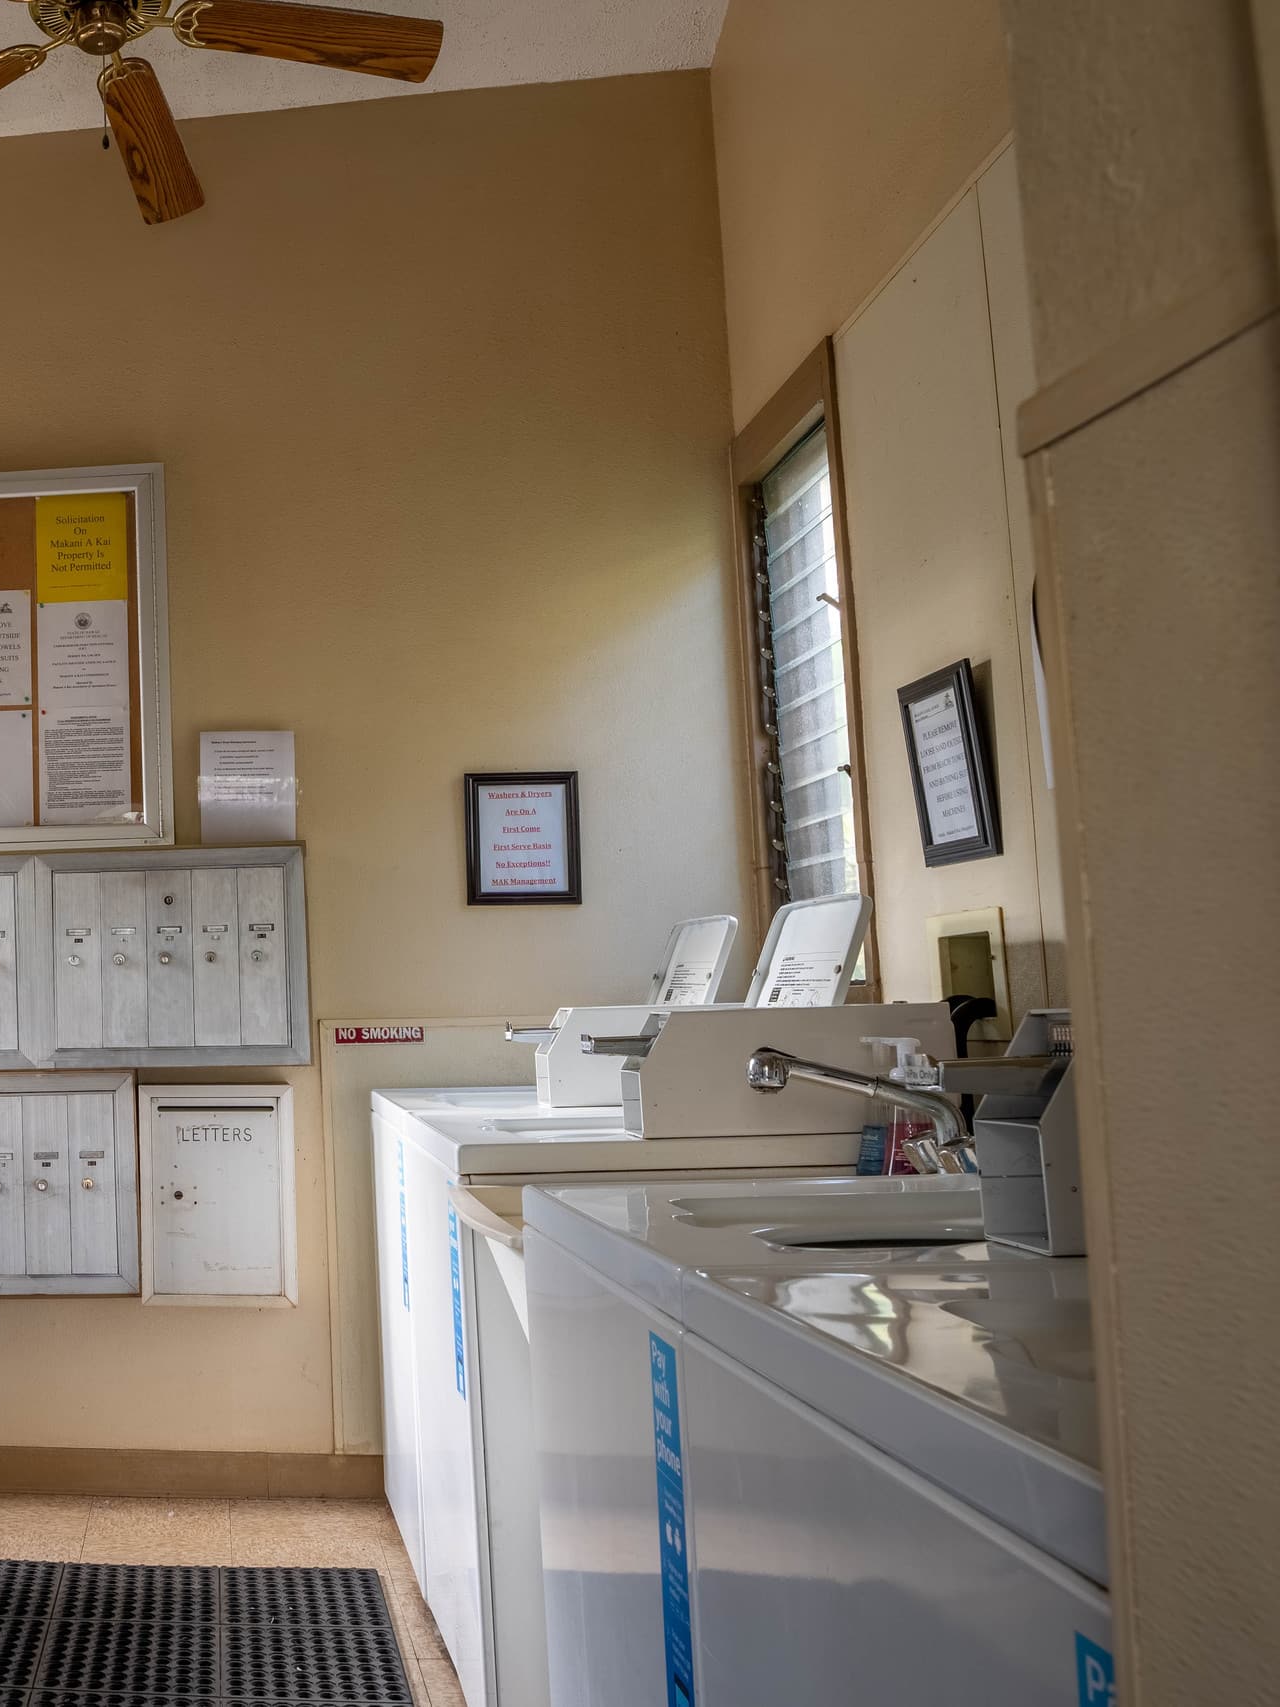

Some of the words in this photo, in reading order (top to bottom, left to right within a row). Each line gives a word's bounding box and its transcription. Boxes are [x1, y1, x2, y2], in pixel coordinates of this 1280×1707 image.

[56, 514, 105, 525] Solicitation
[73, 527, 87, 535] On
[50, 539, 83, 549] Makani
[86, 538, 92, 546] A
[96, 537, 111, 546] Kai
[57, 550, 93, 561] Property
[97, 550, 104, 558] Is
[51, 564, 67, 573] Not
[70, 561, 111, 572] Permitted
[922, 726, 938, 741] PLEASE
[937, 719, 957, 734] REMOVE
[920, 745, 935, 759] LOOSE
[935, 741, 946, 753] SAND
[923, 762, 937, 775] FROM
[937, 757, 951, 770] BEACH
[928, 779, 939, 789] AND
[939, 772, 958, 787] BATHING
[488, 791, 519, 799] Washers
[528, 791, 552, 799] Dryers
[936, 791, 952, 803] BEFORE
[952, 786, 968, 799] USING
[519, 808, 530, 816] On
[942, 804, 966, 818] MACHINES
[521, 825, 541, 833] Come
[493, 843, 510, 851] First
[507, 860, 551, 869] Exceptions!!
[510, 877, 557, 886] Management
[338, 1028, 356, 1040] NO
[361, 1026, 421, 1040] SMOKING
[919, 1068, 935, 1081] Only
[181, 1127, 253, 1142] LETTERS
[651, 1340, 666, 1378] Pay
[653, 1374, 670, 1409] with
[655, 1406, 673, 1438] your
[657, 1434, 681, 1477] phone
